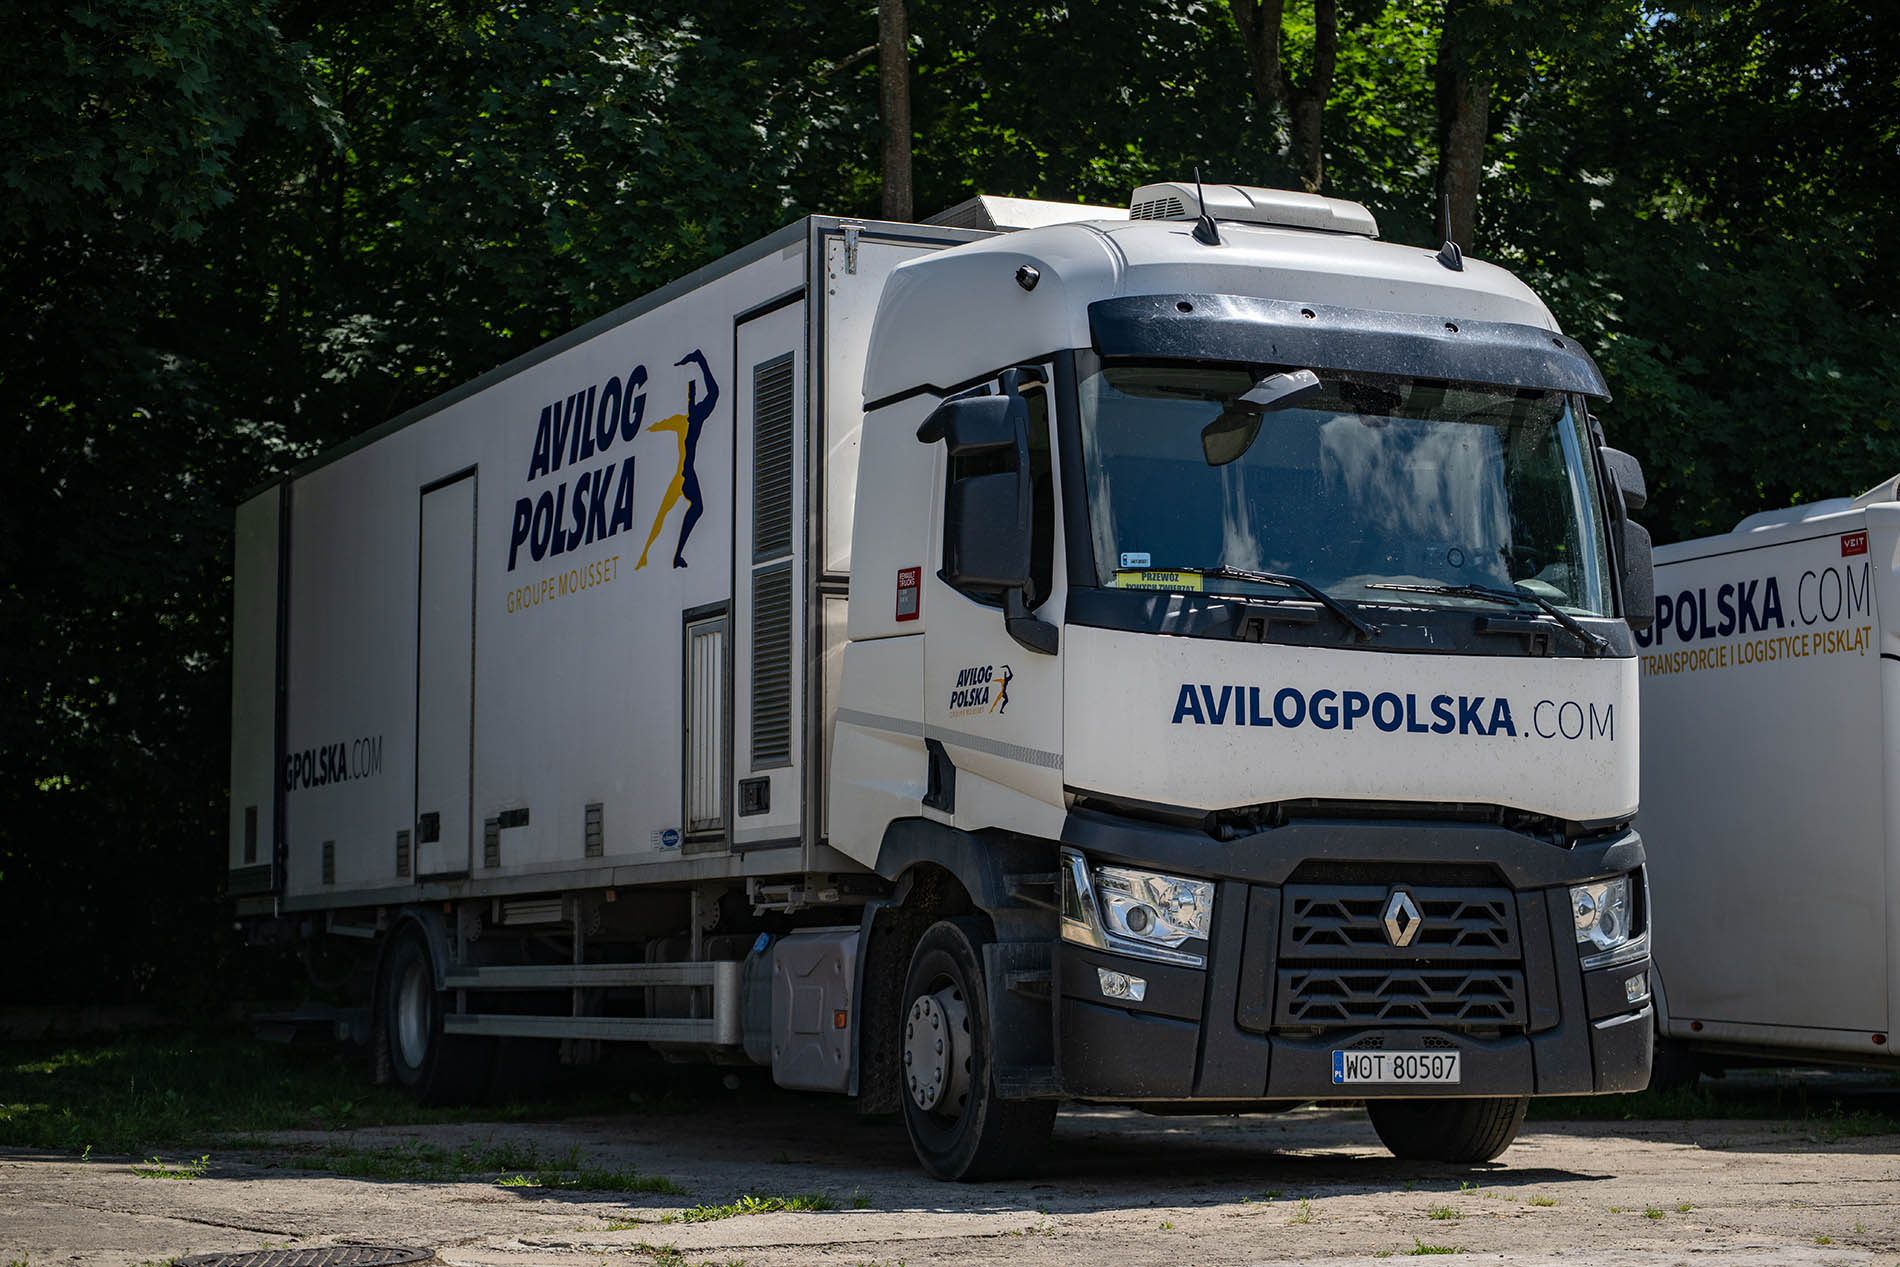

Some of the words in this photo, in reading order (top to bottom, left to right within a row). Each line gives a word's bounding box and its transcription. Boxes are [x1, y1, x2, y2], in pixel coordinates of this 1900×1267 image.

[527, 364, 648, 482] AVILOG
[507, 455, 636, 572] POLSKA
[1843, 537, 1865, 548] VEIT
[506, 576, 555, 614] GROUPE
[557, 555, 620, 598] MOUSSET
[1642, 644, 1726, 677] TRANSPORCIE
[1730, 646, 1735, 666] I
[1737, 633, 1809, 665] LOGISTYCE
[1813, 626, 1872, 656] PISKLĄT
[955, 664, 993, 688] AVILOG
[949, 686, 989, 709] POLSKA
[1171, 683, 1615, 742] AVILOGPOLSKA.COM
[1334, 1070, 1343, 1078] PL
[1346, 1055, 1385, 1079] WOT
[1393, 1055, 1456, 1079] 80507
